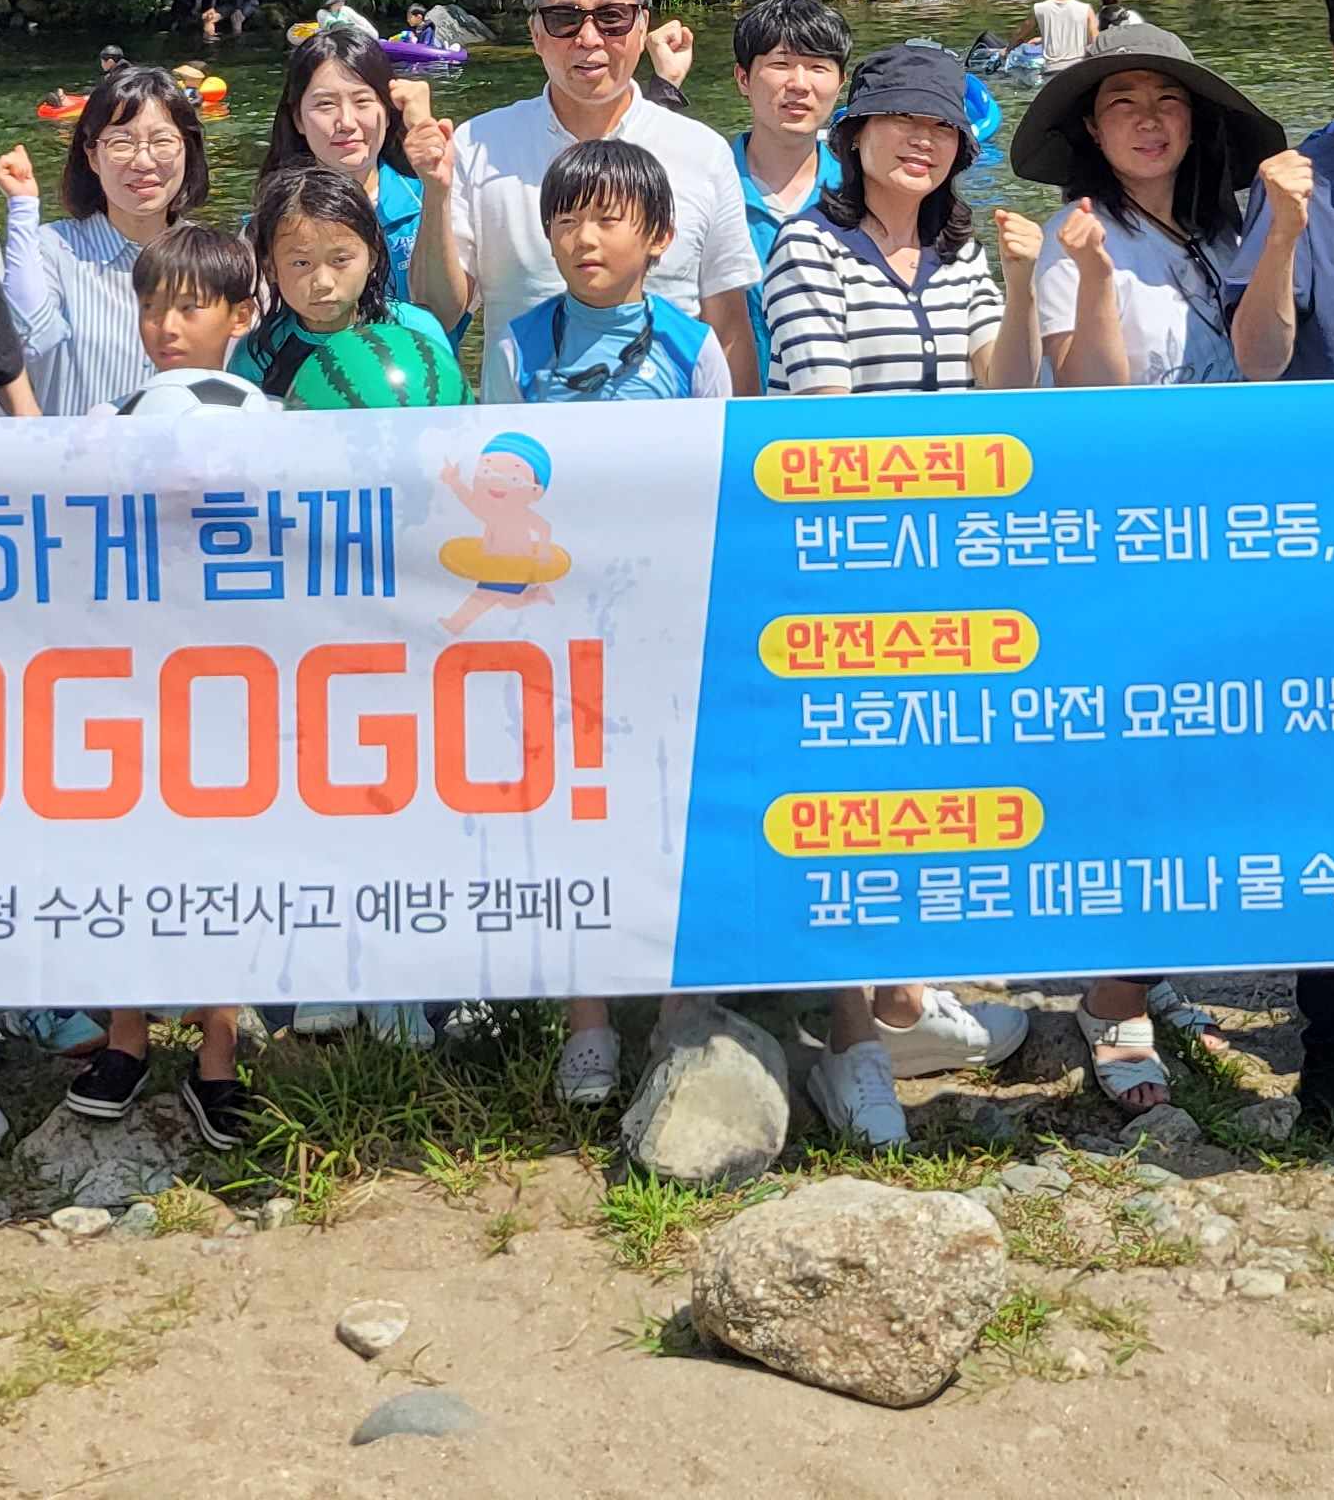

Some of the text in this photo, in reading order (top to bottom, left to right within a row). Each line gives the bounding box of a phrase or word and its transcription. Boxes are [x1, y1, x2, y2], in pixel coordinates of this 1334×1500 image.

[781, 441, 1006, 496] 안전수칙 1
[191, 486, 396, 601] 함께
[794, 512, 940, 572] 반드시
[954, 508, 1101, 568] 충분한
[1115, 504, 1209, 563] 준비
[1223, 501, 1334, 562] 운동,
[785, 616, 1023, 671] 안전수칙 2
[799, 688, 996, 748] 보호자나
[1010, 684, 1105, 743] 안전
[1122, 679, 1264, 739] 요원이
[790, 794, 1025, 850] 안전수칙 3
[33, 883, 134, 940] 수상
[145, 881, 342, 938] 안전사고
[355, 877, 454, 934] 예방
[466, 874, 613, 933] 캠페인
[805, 867, 902, 928] 깊은
[917, 863, 1014, 923] 물로
[1028, 856, 1223, 917] 떠밀거나
[1236, 854, 1285, 911] 물
